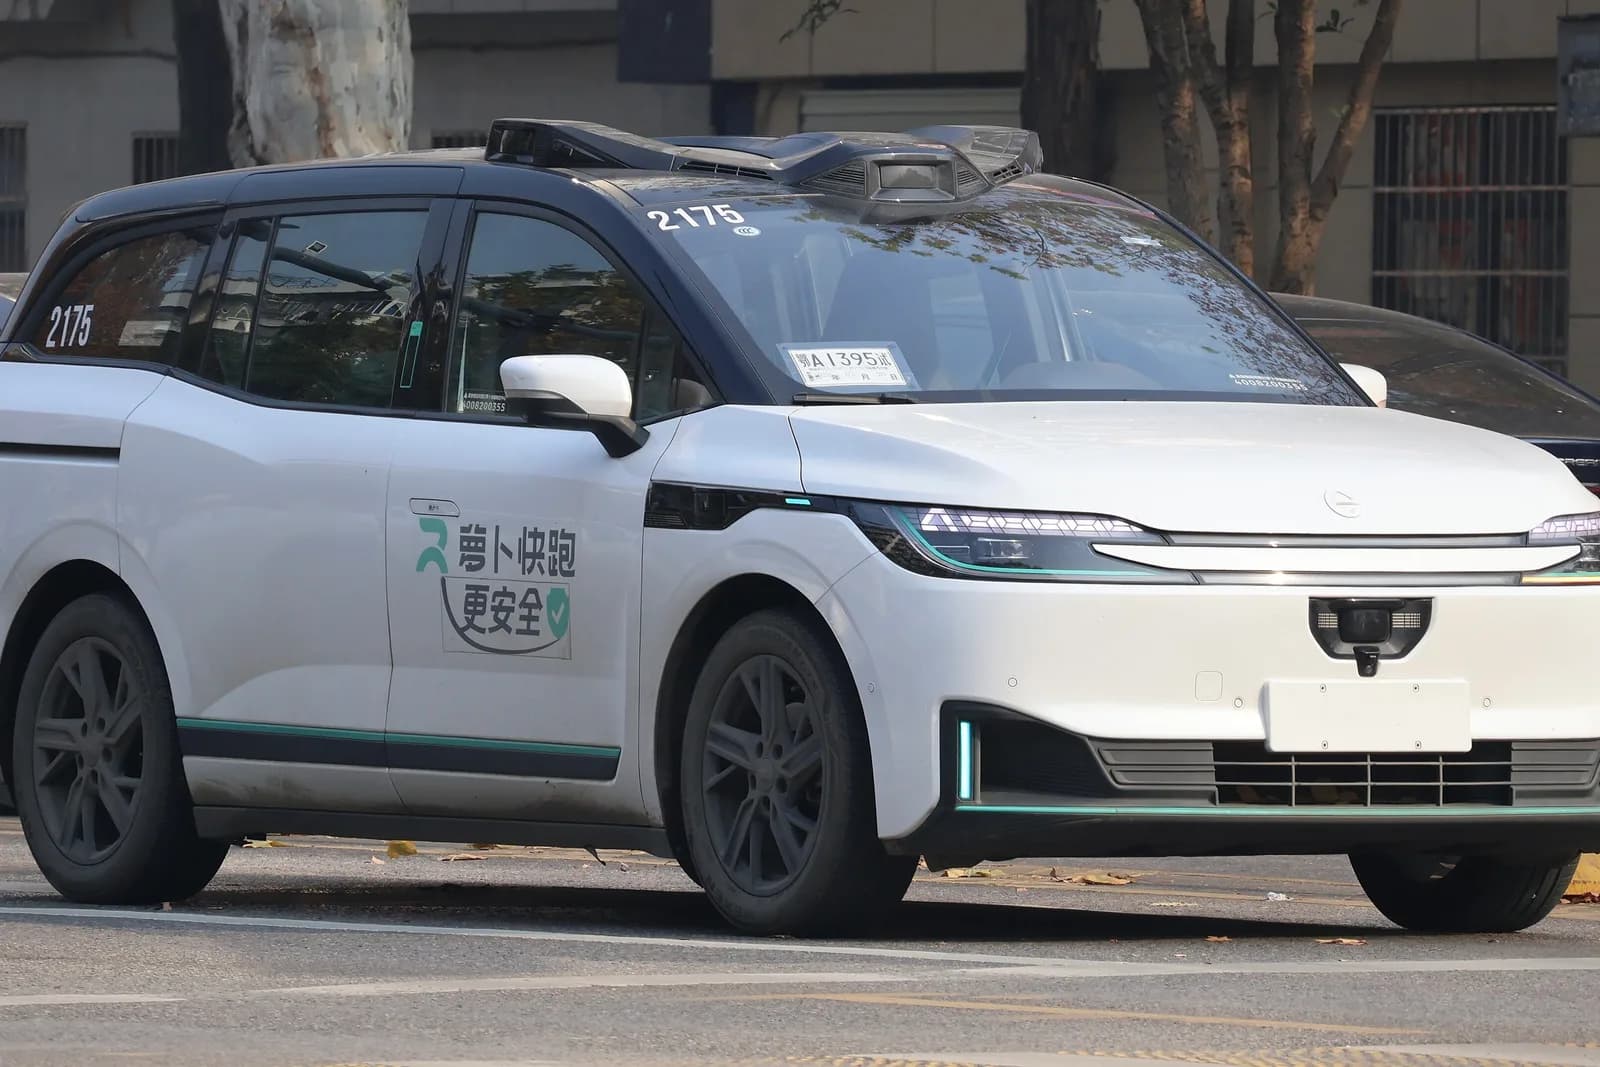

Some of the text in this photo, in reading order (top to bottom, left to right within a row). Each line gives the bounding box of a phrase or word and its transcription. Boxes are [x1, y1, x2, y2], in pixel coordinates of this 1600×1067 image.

[646, 204, 745, 231] 2175
[45, 304, 94, 348] 2175
[458, 524, 576, 578] 萝卜快跑
[461, 584, 543, 636] 更安全
